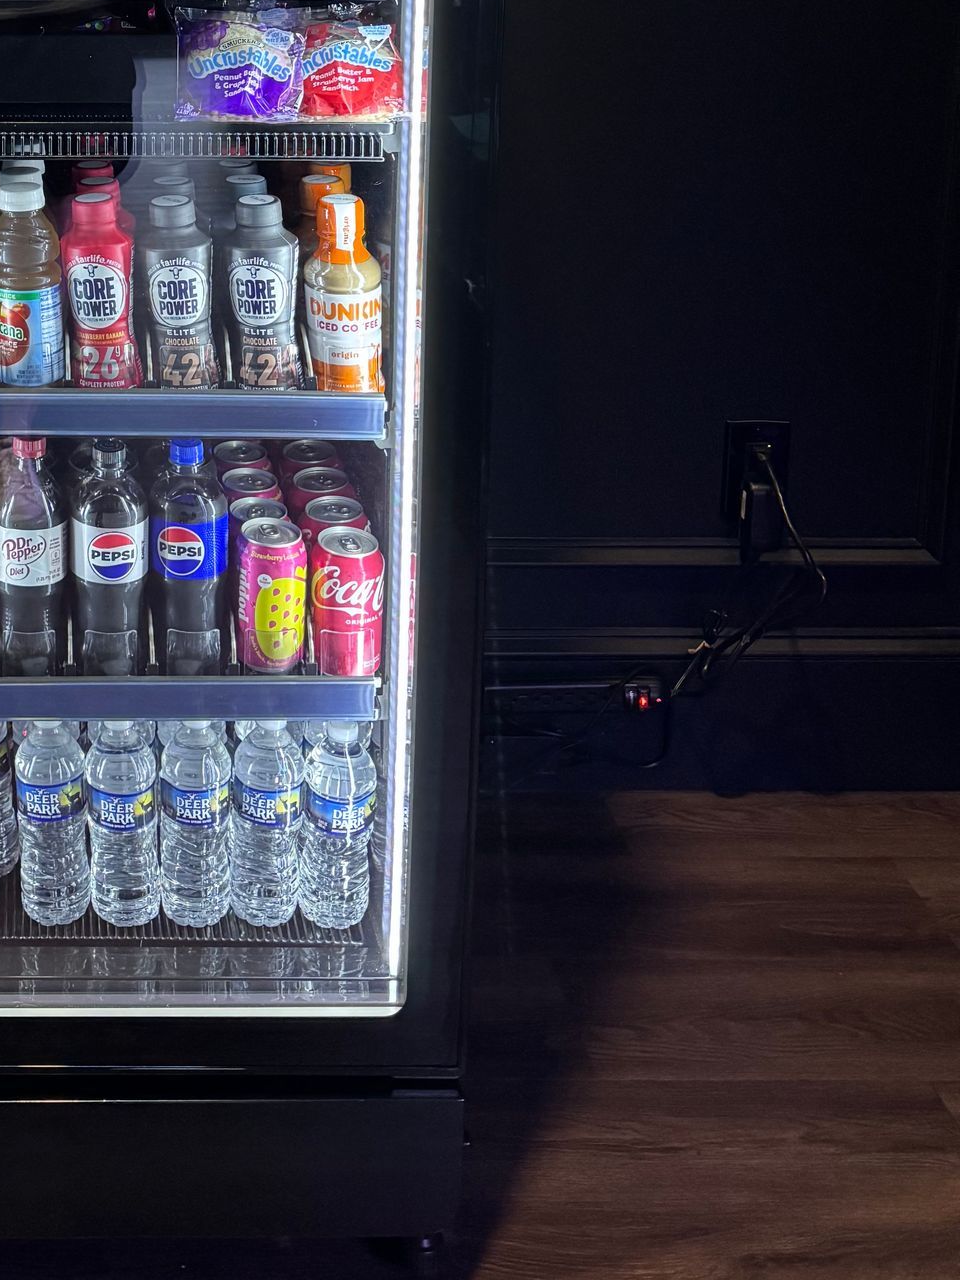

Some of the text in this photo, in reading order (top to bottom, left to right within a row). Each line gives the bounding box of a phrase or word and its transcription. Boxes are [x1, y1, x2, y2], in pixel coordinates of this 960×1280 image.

[189, 46, 291, 81] Uncrustables
[301, 42, 393, 77] ncrustables
[214, 73, 243, 81] Peanut
[310, 68, 336, 81] Peanut
[337, 66, 364, 76] Butter
[321, 82, 360, 92] Sandwich
[74, 254, 105, 264] fairlife
[160, 257, 191, 268] fairlife
[238, 256, 269, 267] fairlife
[73, 276, 116, 301] CORE
[157, 277, 198, 301] CORE
[235, 277, 277, 300] CORE
[76, 299, 118, 318] POWER
[159, 299, 199, 317] POWER
[237, 298, 277, 316] POWER
[166, 327, 196, 336] ELITE
[244, 327, 274, 336] ELITE
[316, 320, 339, 332] ICED
[164, 336, 201, 346] CHOCOLATE
[242, 336, 278, 346] CHOCOLATE
[163, 352, 202, 387] 42
[239, 352, 278, 387] 42
[103, 379, 126, 388] PROTEIN
[6, 538, 44, 562] Pepper
[16, 536, 33, 550] Dr
[159, 540, 202, 557] PEPSI
[91, 548, 135, 562] PEPSI
[9, 567, 24, 576] Diet
[25, 791, 60, 804] DEER
[176, 795, 211, 809] DEER
[242, 792, 276, 809] DEER
[26, 801, 61, 816] PARK
[100, 799, 135, 814] DEER
[176, 806, 212, 820] PARK
[241, 805, 276, 820] PARK
[332, 805, 365, 820] DEER
[100, 810, 135, 825] PARK
[331, 816, 365, 830] PARK
